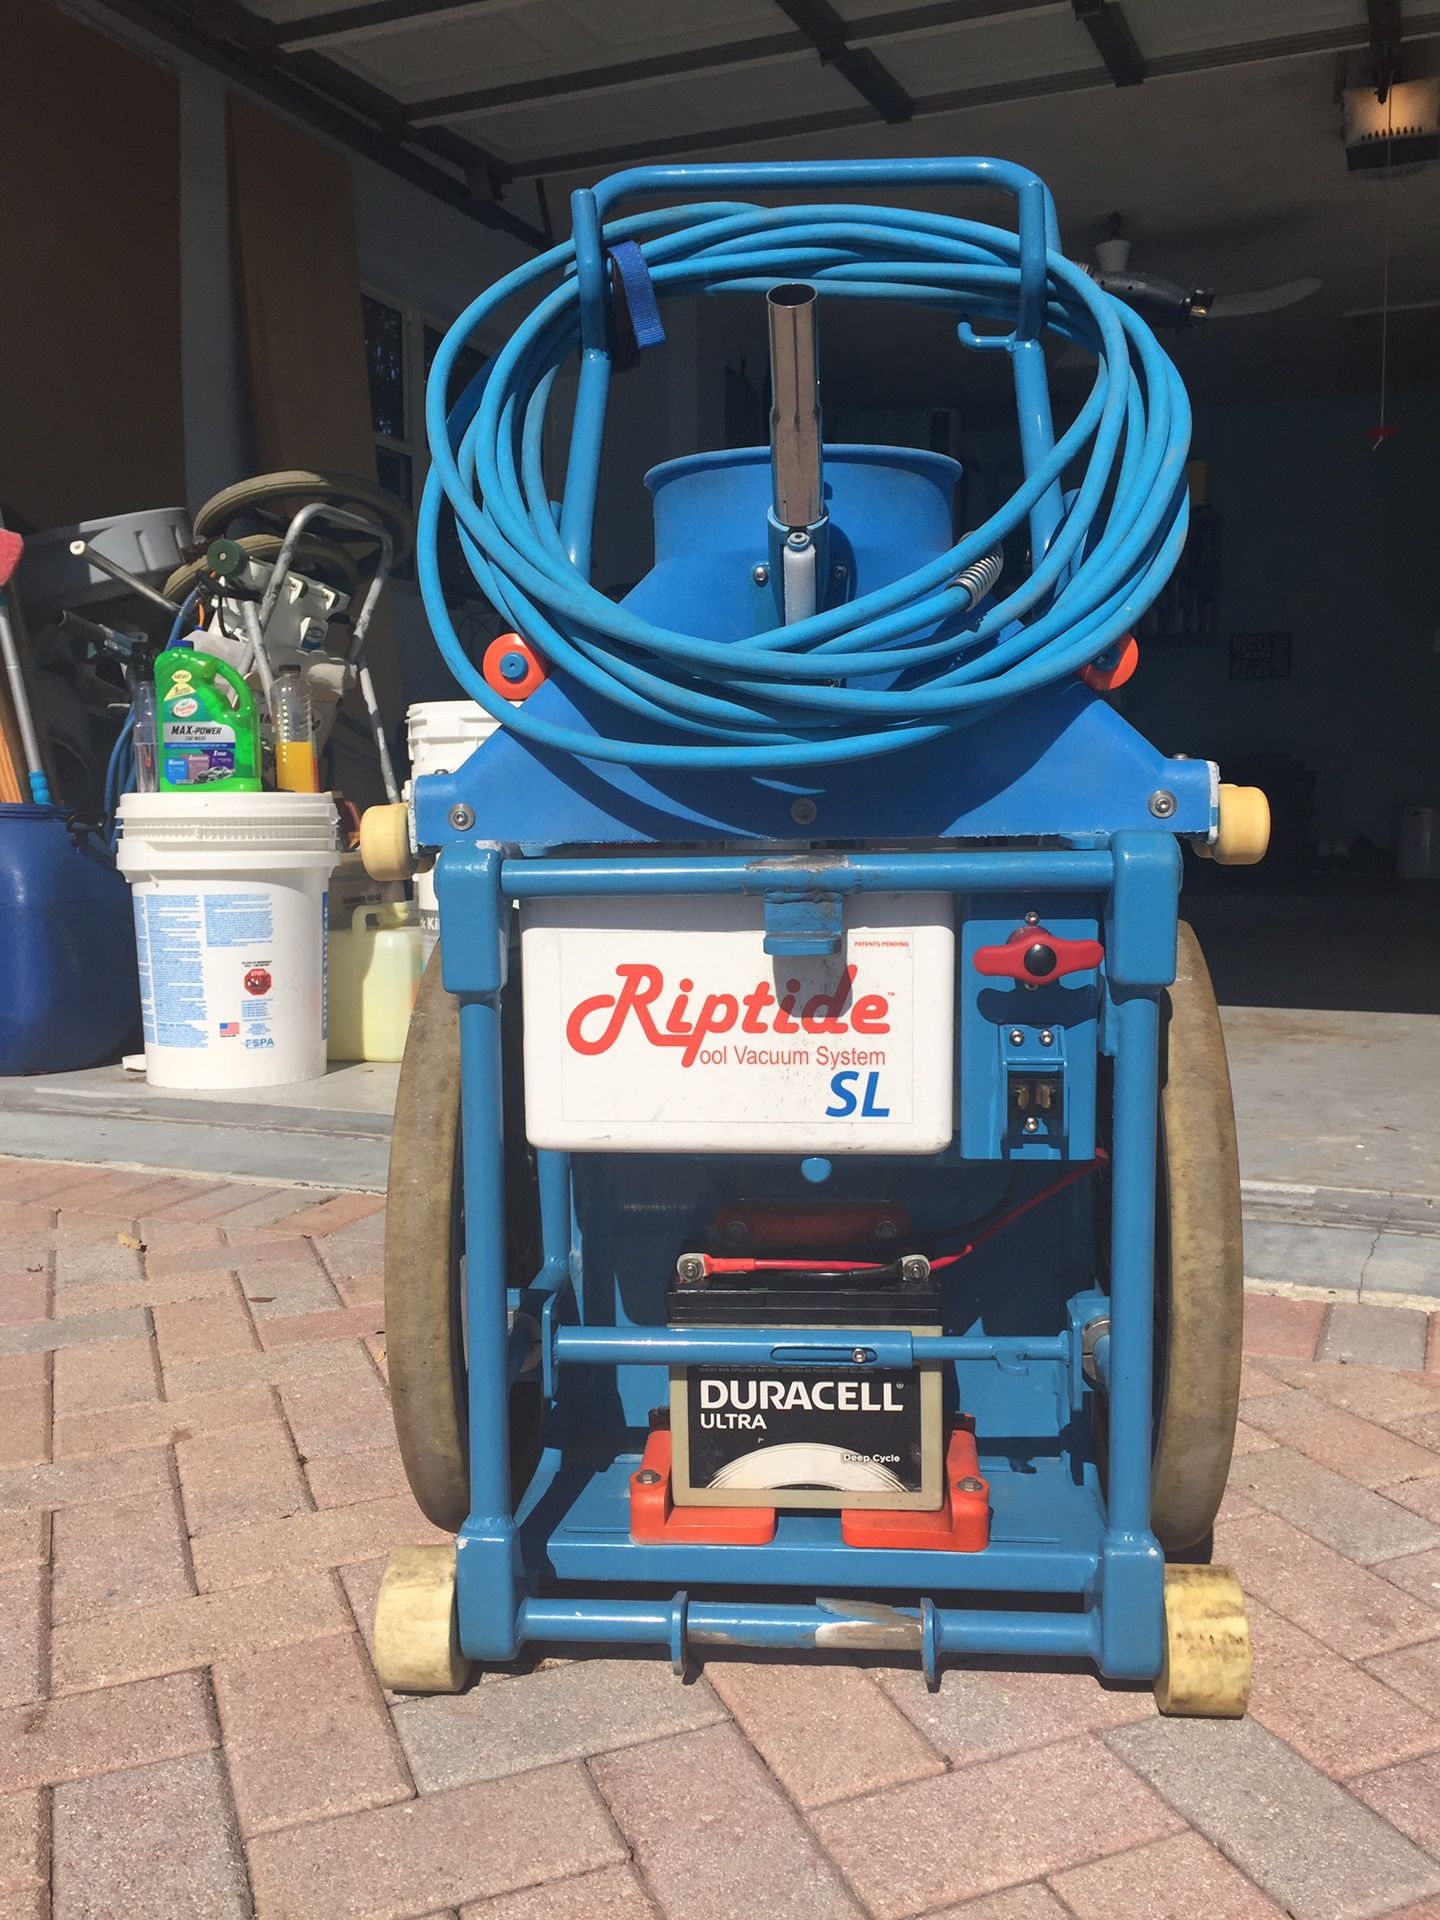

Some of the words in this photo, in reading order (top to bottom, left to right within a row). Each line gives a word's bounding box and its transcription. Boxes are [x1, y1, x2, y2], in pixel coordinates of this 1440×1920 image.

[171, 725, 222, 735] MAX-POWER
[566, 963, 891, 1068] Riptide
[733, 1045, 809, 1065] Vacuum
[816, 1045, 886, 1070] System
[825, 1070, 890, 1118] SL
[700, 1379, 904, 1412] DURACELL
[700, 1413, 767, 1430] ULTRA
[843, 1453, 870, 1463] Deep
[872, 1454, 900, 1463] Cycle
